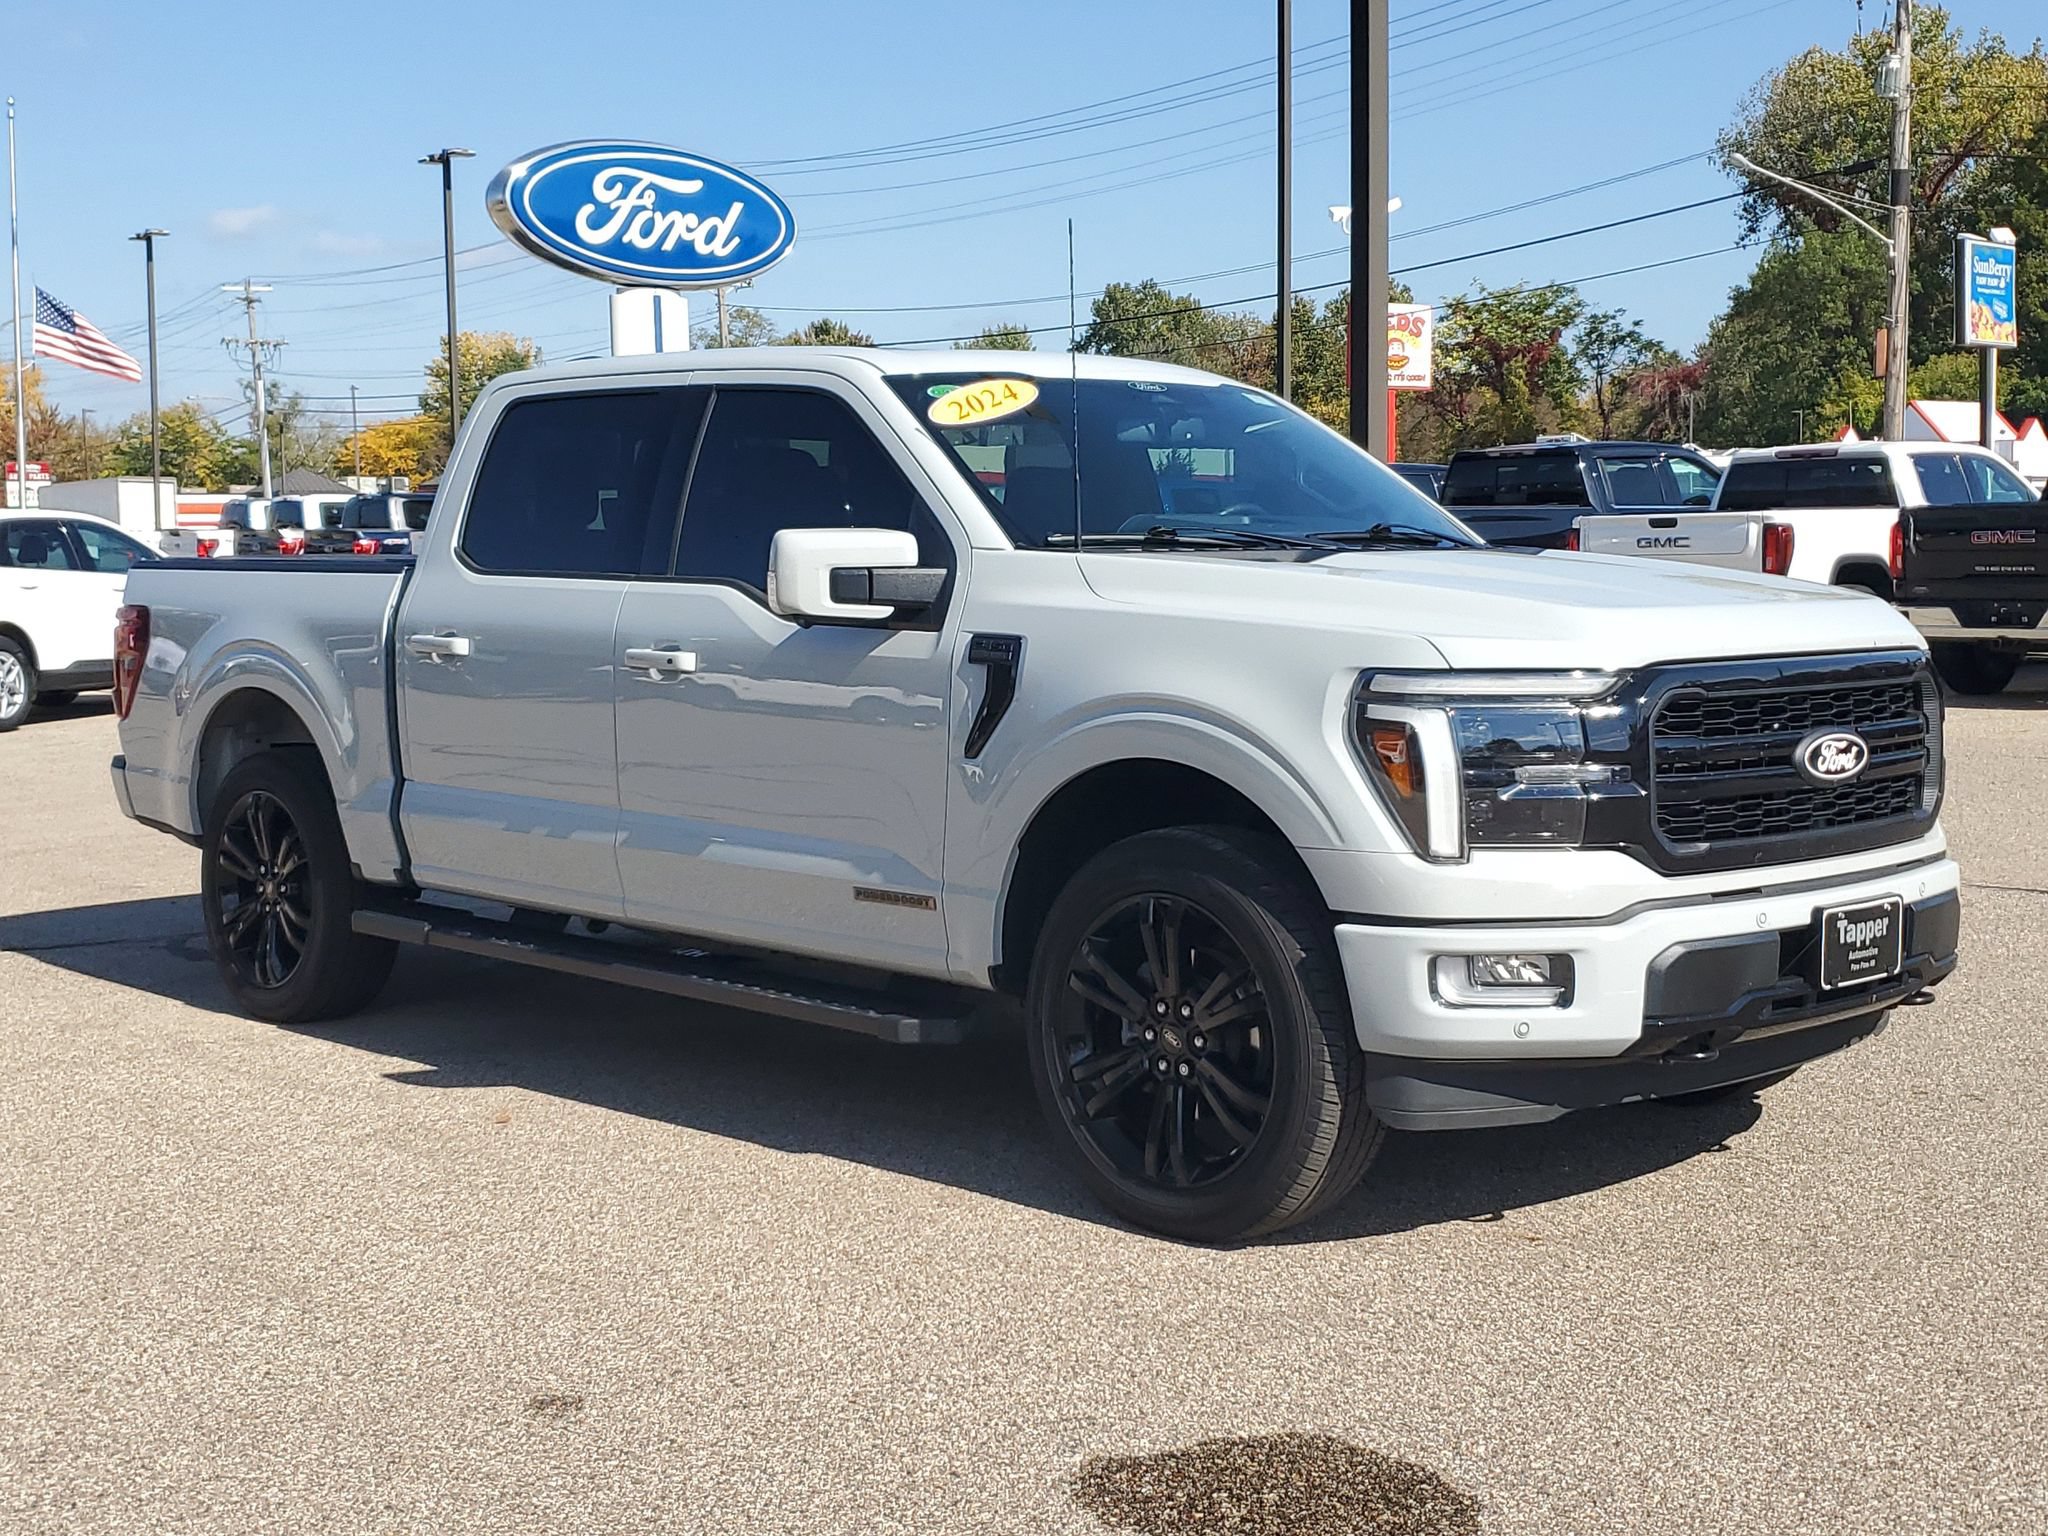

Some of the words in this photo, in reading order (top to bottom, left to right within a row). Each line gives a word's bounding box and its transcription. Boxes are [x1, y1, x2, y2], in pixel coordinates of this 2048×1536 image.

[575, 166, 745, 257] Ford
[1973, 255, 2012, 283] SunBerry
[948, 383, 1018, 420] 2024
[1637, 537, 1691, 548] GMC
[1971, 529, 2036, 544] GMC
[1817, 740, 1860, 772] Ford
[1837, 916, 1889, 948] Tapper
[1848, 946, 1879, 960] Automotive
